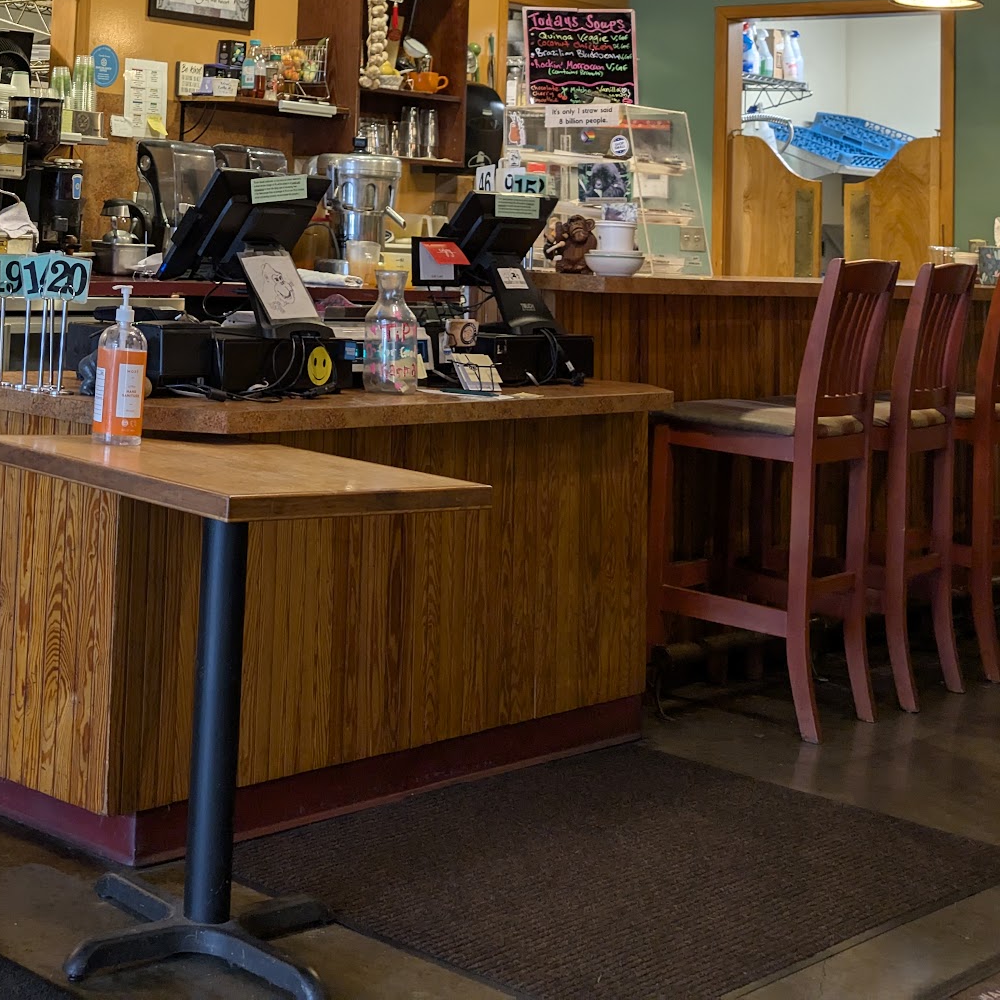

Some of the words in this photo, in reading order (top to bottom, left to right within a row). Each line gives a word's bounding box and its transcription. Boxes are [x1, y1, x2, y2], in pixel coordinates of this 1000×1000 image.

[528, 12, 579, 28] Todays
[585, 14, 625, 30] Soups
[538, 32, 574, 40] Quinoa
[577, 32, 609, 44] Veggie
[535, 47, 574, 57] Brazilian
[562, 108, 576, 116] only
[585, 117, 608, 125] people.
[47, 260, 88, 297] 20
